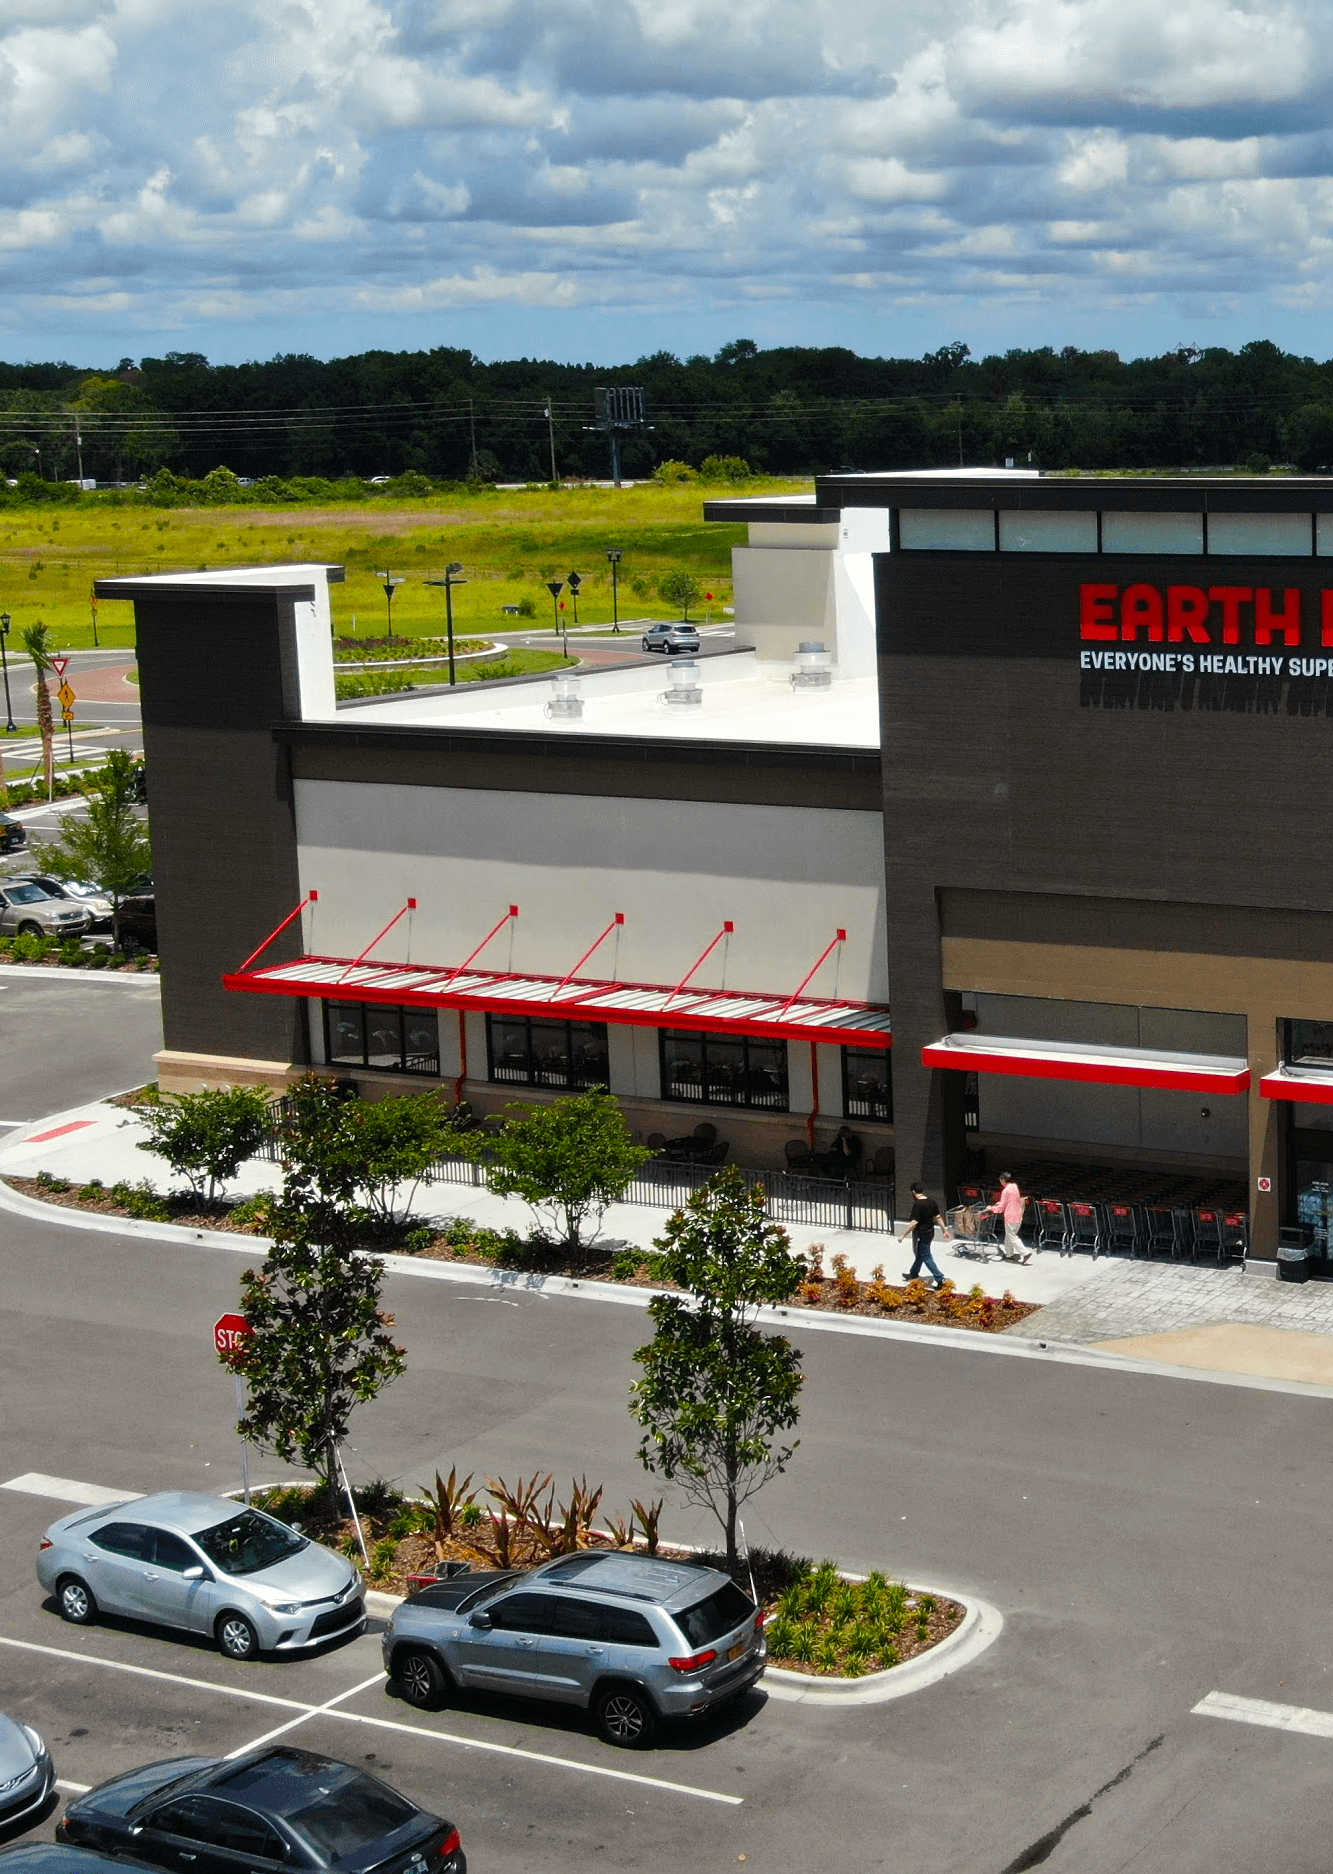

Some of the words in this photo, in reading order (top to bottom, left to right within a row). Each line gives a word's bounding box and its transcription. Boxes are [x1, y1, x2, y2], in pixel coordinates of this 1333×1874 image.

[1080, 584, 1301, 646] EARTH
[1080, 650, 1195, 672] EVERYONE'S
[1199, 655, 1284, 675] HEALTHY
[217, 1328, 246, 1351] STO
